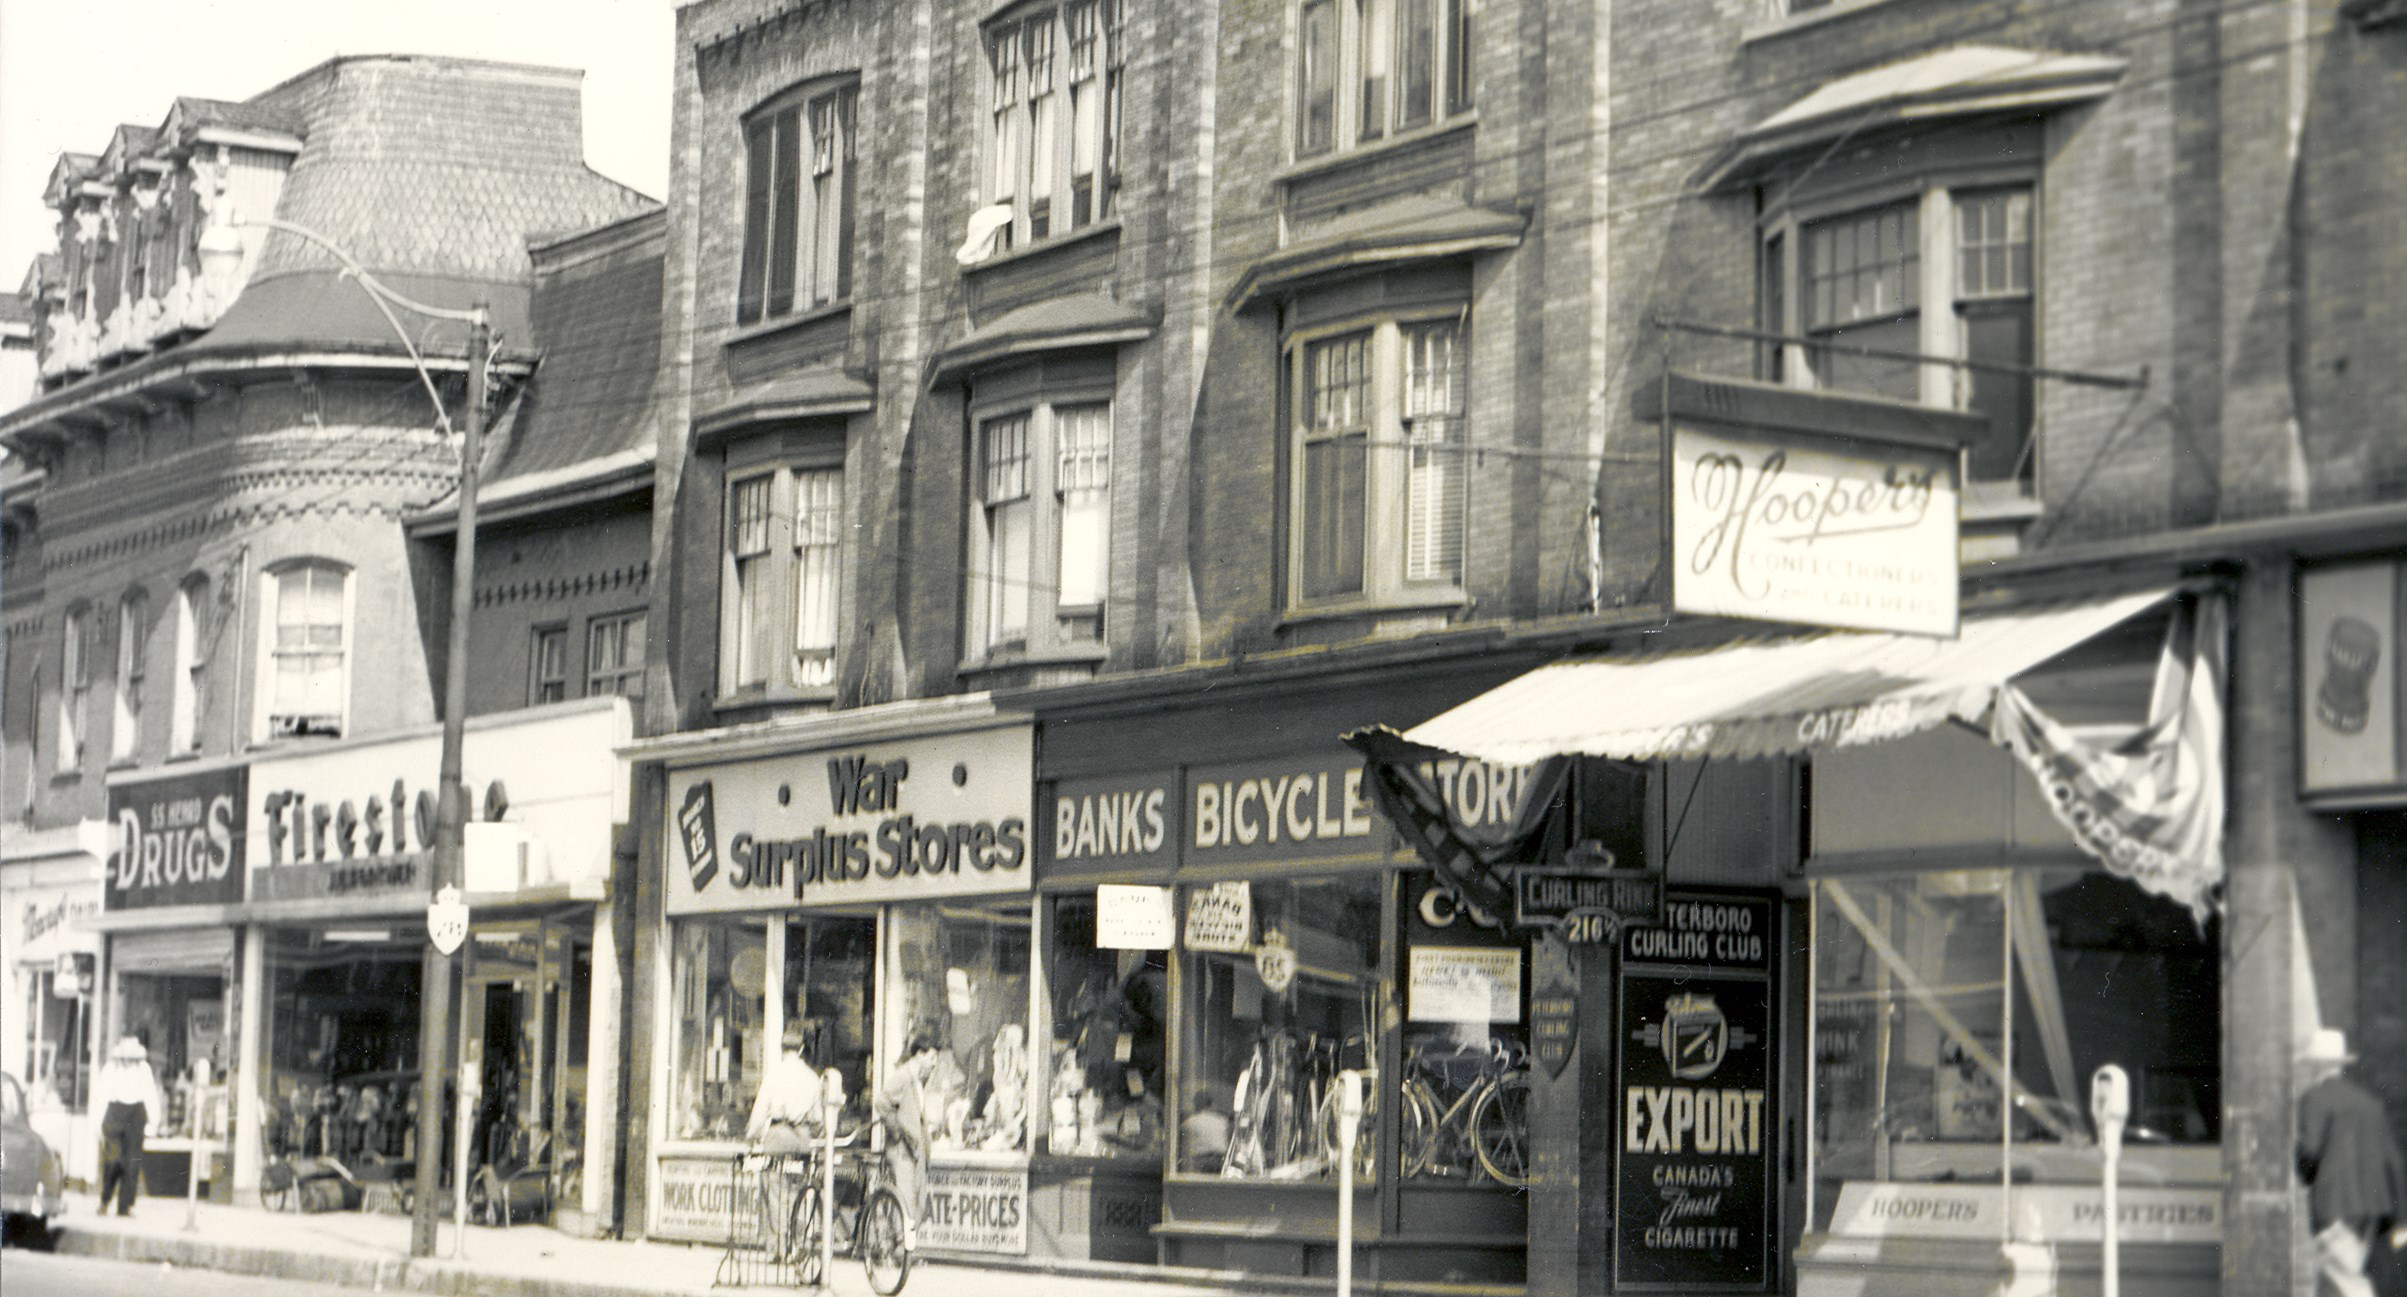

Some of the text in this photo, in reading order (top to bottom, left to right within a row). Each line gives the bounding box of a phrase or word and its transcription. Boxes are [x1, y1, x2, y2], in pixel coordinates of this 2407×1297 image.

[827, 753, 909, 818] War
[1055, 757, 1534, 860] BANKS BICYCLE TOR
[115, 794, 234, 891] DRUGS
[729, 824, 871, 902] Surplus
[874, 813, 1026, 877] Stores
[1528, 878, 1609, 909] CURLING
[1666, 901, 1752, 934] TERBORO
[1630, 927, 1763, 962] CURLING CLUB
[1626, 1085, 1764, 1155] EXPORT
[1652, 1164, 1734, 1189] CANADA'S
[663, 1181, 696, 1213] WORK
[920, 1191, 1020, 1228] ATE-PRICES
[1658, 1185, 1722, 1228] Finest
[1872, 1198, 1979, 1221] HOOPERS
[1644, 1226, 1739, 1250] CIGARETTE
